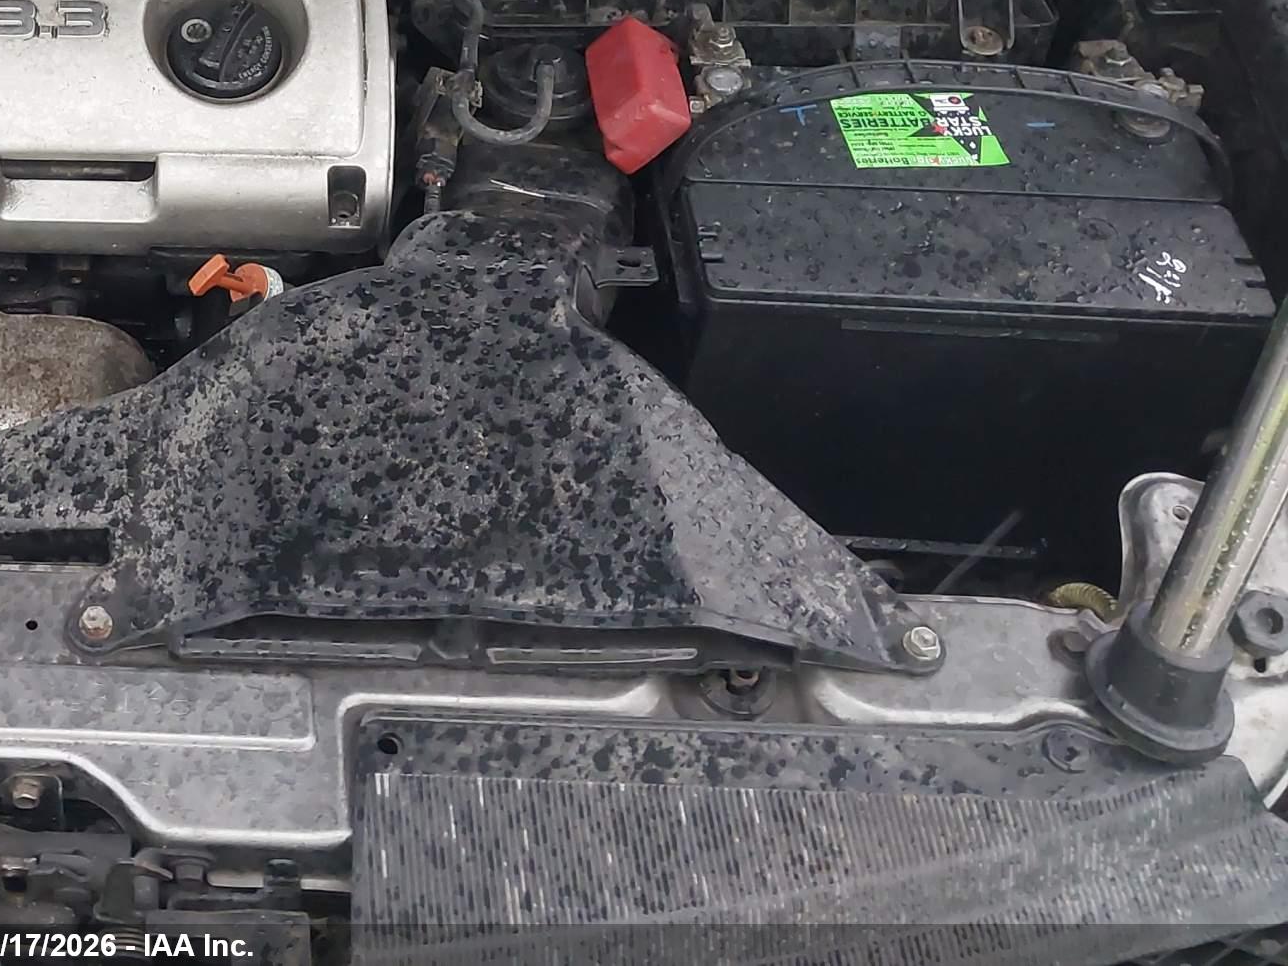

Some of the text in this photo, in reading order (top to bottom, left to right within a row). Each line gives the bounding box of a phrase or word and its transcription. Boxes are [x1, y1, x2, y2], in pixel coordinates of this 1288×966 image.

[840, 118, 930, 129] BATTERIES
[936, 116, 982, 127] STAR
[943, 126, 992, 136] LUCKY
[856, 157, 910, 166] Batteries
